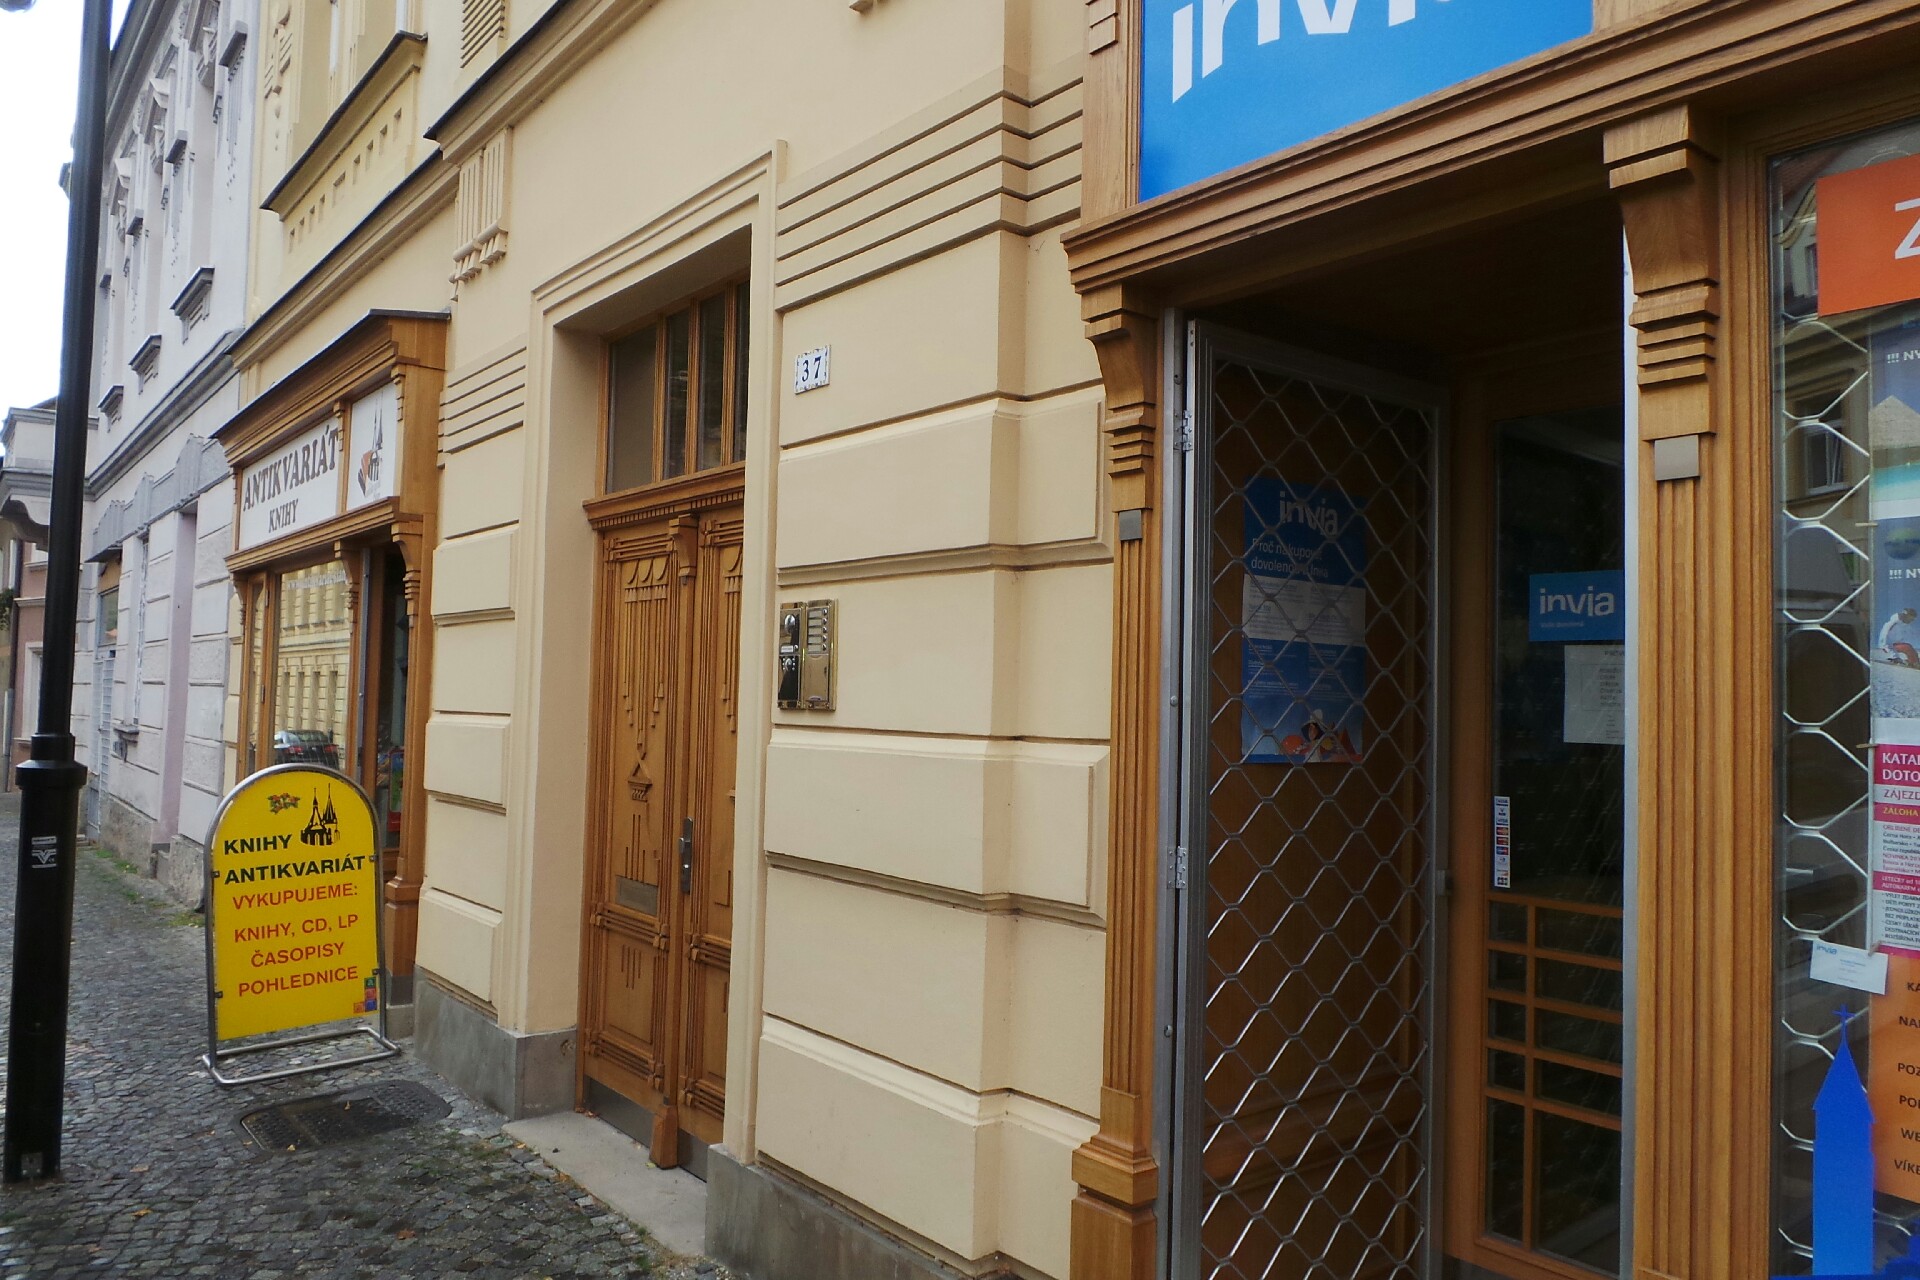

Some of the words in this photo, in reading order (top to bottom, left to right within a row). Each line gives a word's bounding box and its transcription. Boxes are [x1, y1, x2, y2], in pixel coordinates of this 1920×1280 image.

[802, 355, 822, 382] 37
[243, 425, 339, 512] ANTIKVARIÁT
[268, 498, 299, 533] KNIHY
[1280, 490, 1338, 536] invia
[1539, 585, 1615, 617] invia
[224, 834, 292, 855] KNIHY
[224, 854, 366, 885] ANTIKVARIÁT
[233, 883, 358, 910] VYKUPUJEME:
[234, 922, 295, 943] KNIHY,
[302, 917, 332, 934] CD,
[338, 914, 359, 929] LP
[251, 942, 345, 968] ČASOPISY
[238, 966, 359, 997] POHLEDNICE
